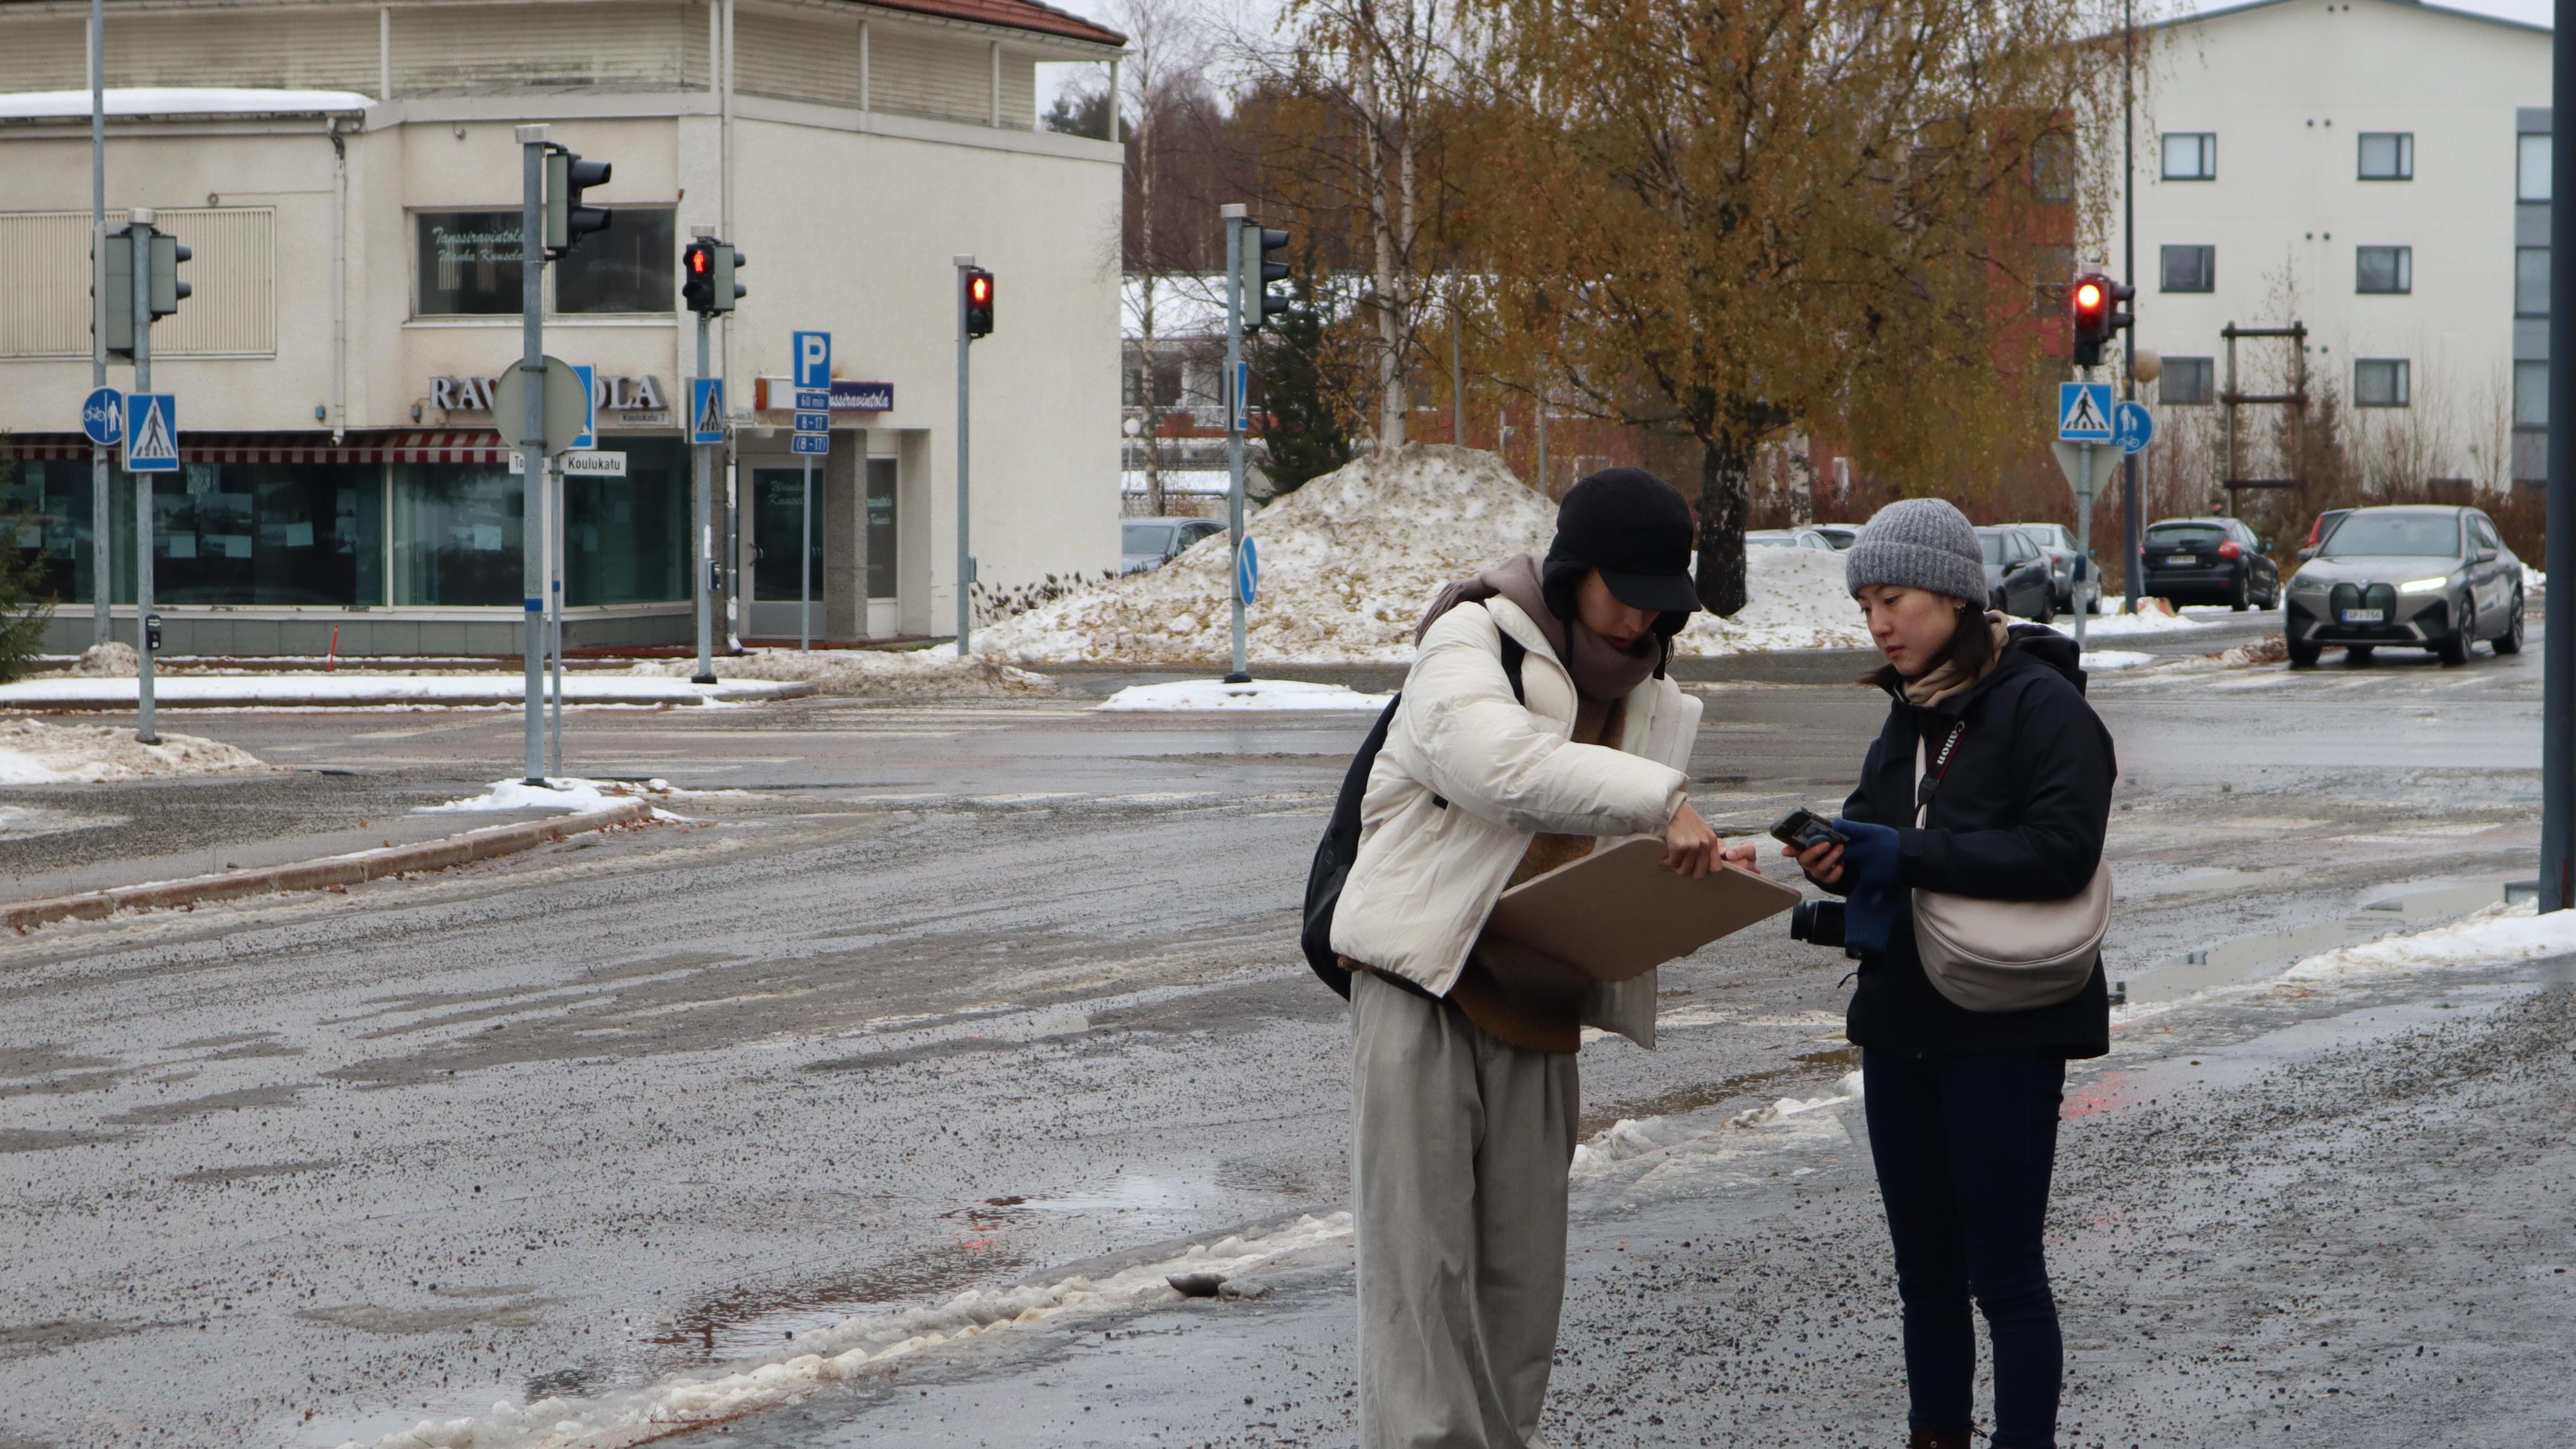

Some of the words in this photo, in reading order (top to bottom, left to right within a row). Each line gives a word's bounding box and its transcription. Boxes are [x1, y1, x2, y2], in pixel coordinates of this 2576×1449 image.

[803, 335, 826, 384] P
[429, 375, 663, 410] RAVLA
[801, 395, 811, 406] 60
[812, 395, 825, 407] min
[568, 456, 621, 470] Koulukatu
[1936, 720, 1965, 765] Canon
